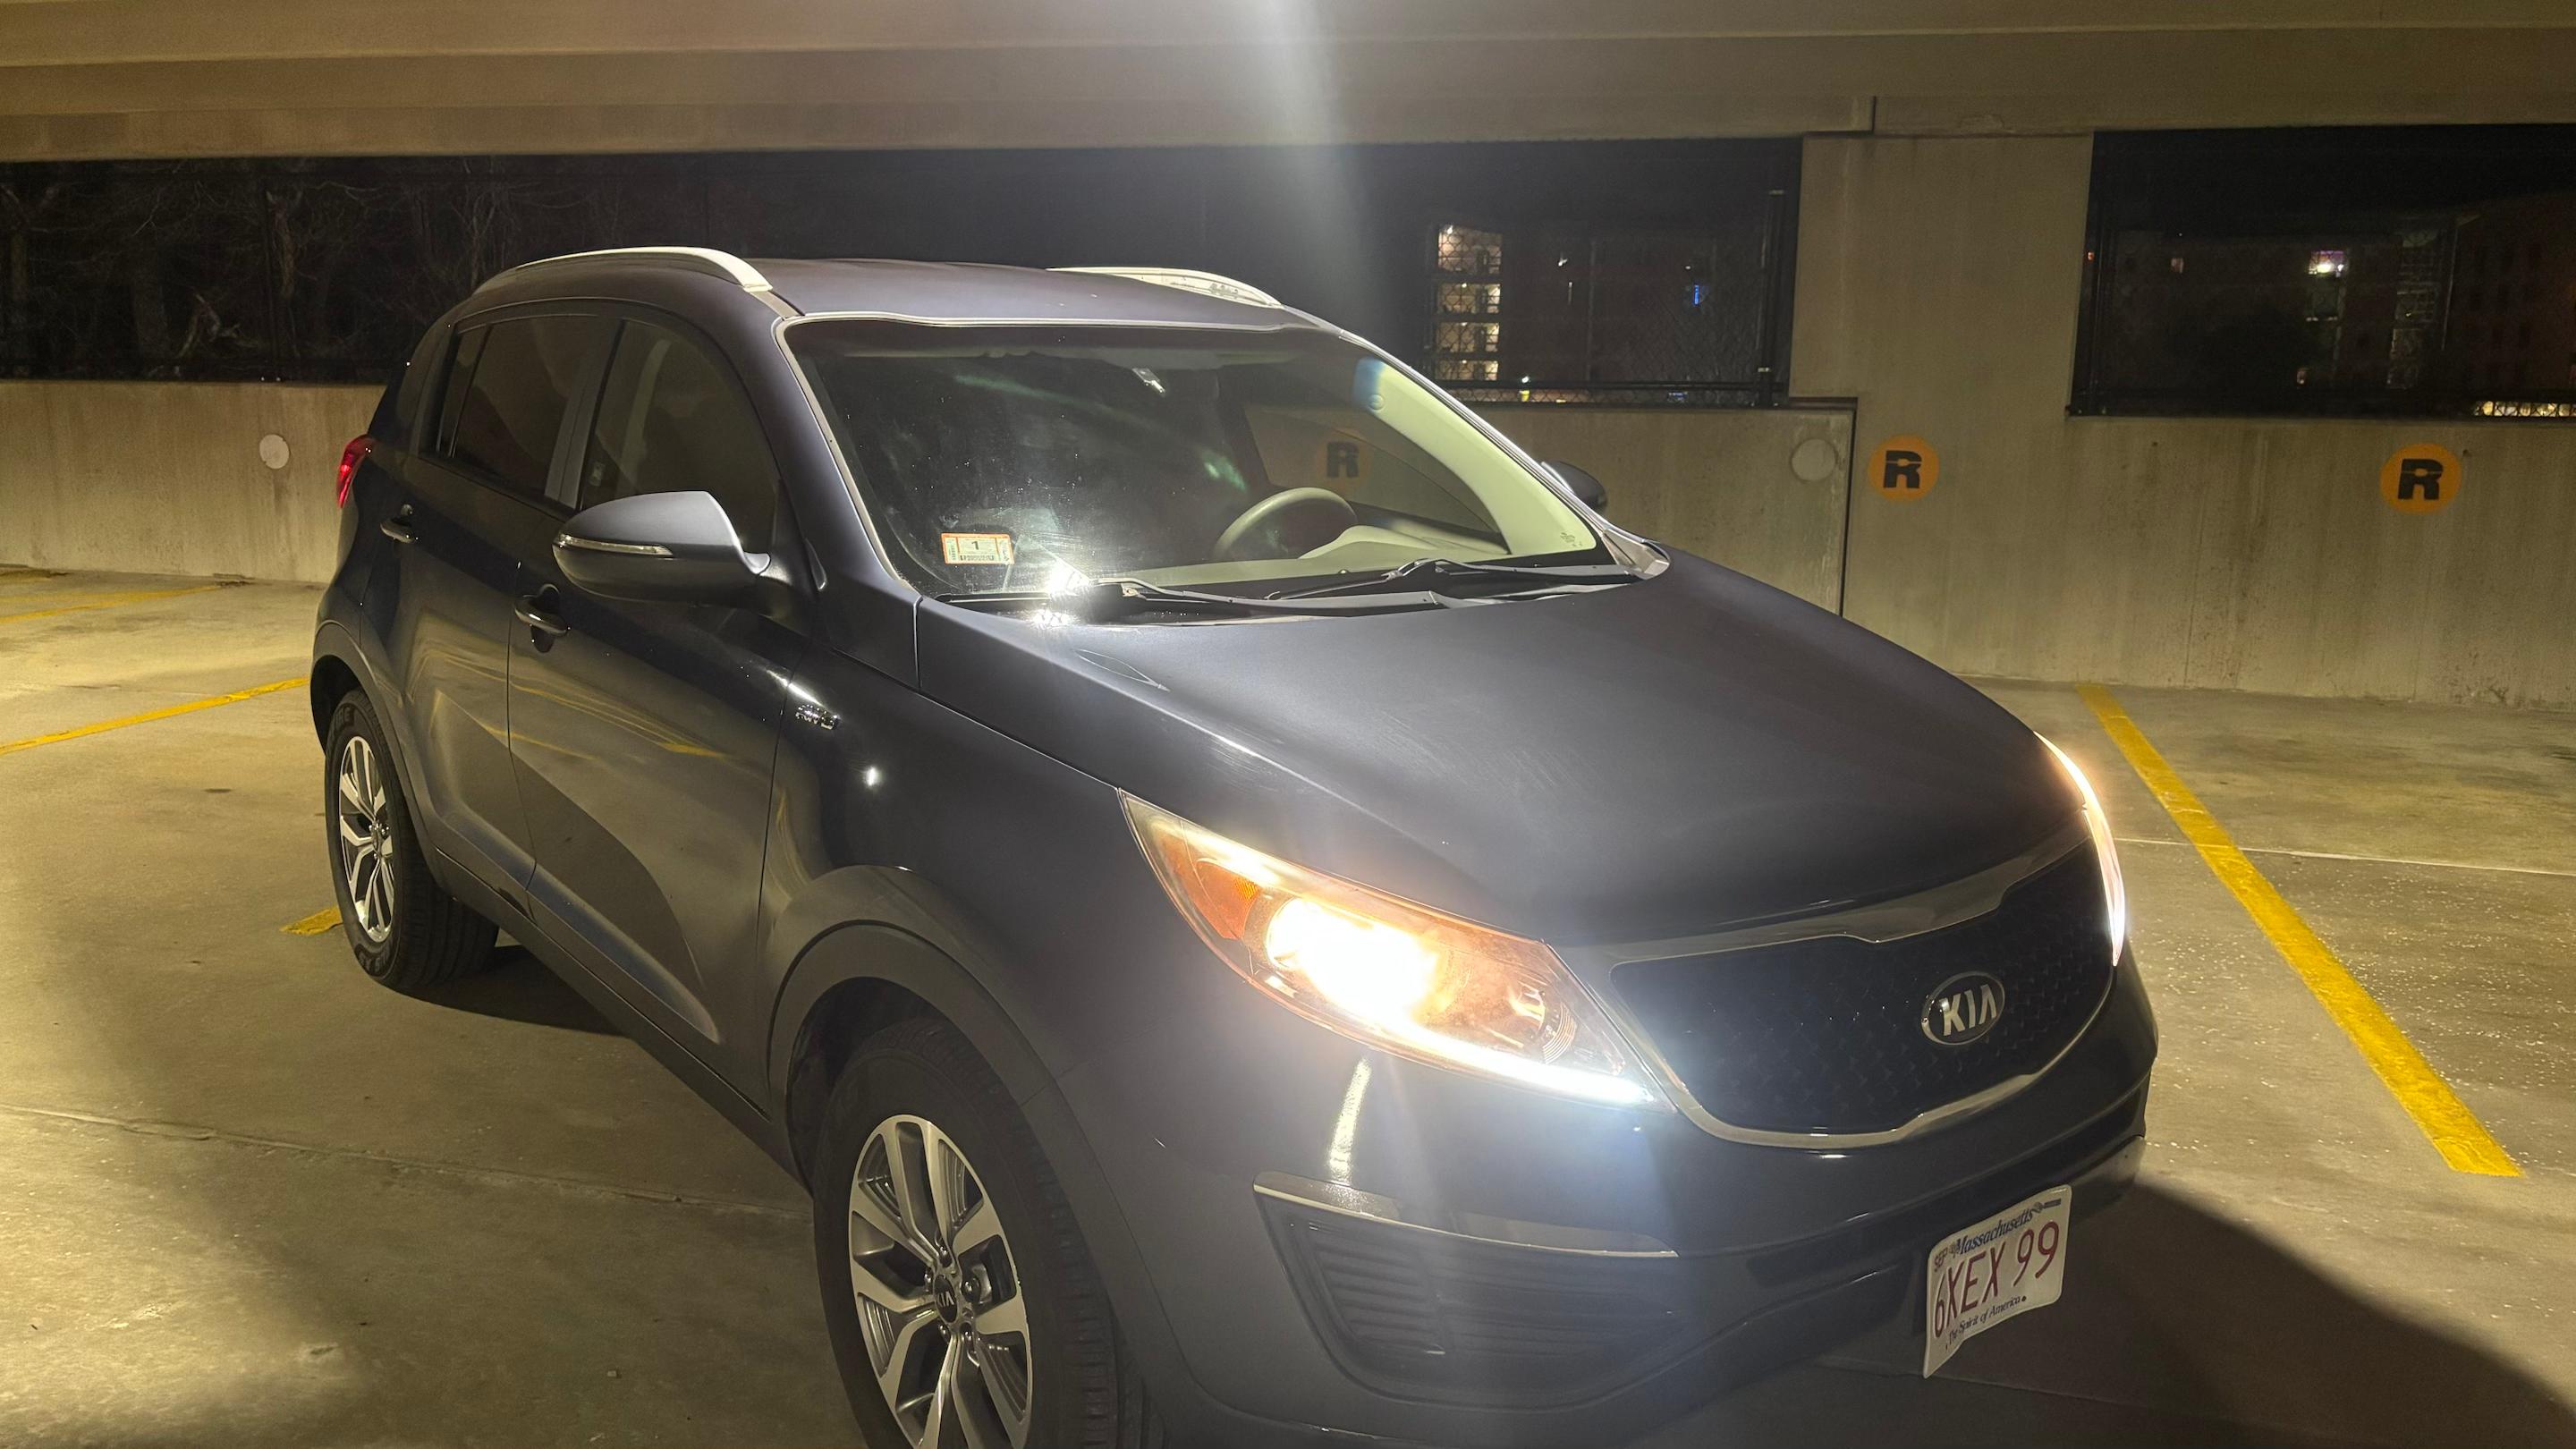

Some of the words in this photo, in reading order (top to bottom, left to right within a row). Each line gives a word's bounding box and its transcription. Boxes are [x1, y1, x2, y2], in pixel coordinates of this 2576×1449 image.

[1326, 442, 1359, 479] R
[1883, 450, 1922, 488] R
[2398, 458, 2443, 500] R
[971, 540, 979, 550] 1
[1939, 984, 1996, 1036] KIA
[1954, 1208, 2033, 1256] Massachusetts
[1934, 1241, 2006, 1338] 6XEX
[2013, 1221, 2060, 1287] 99
[1988, 1296, 2021, 1319] America
